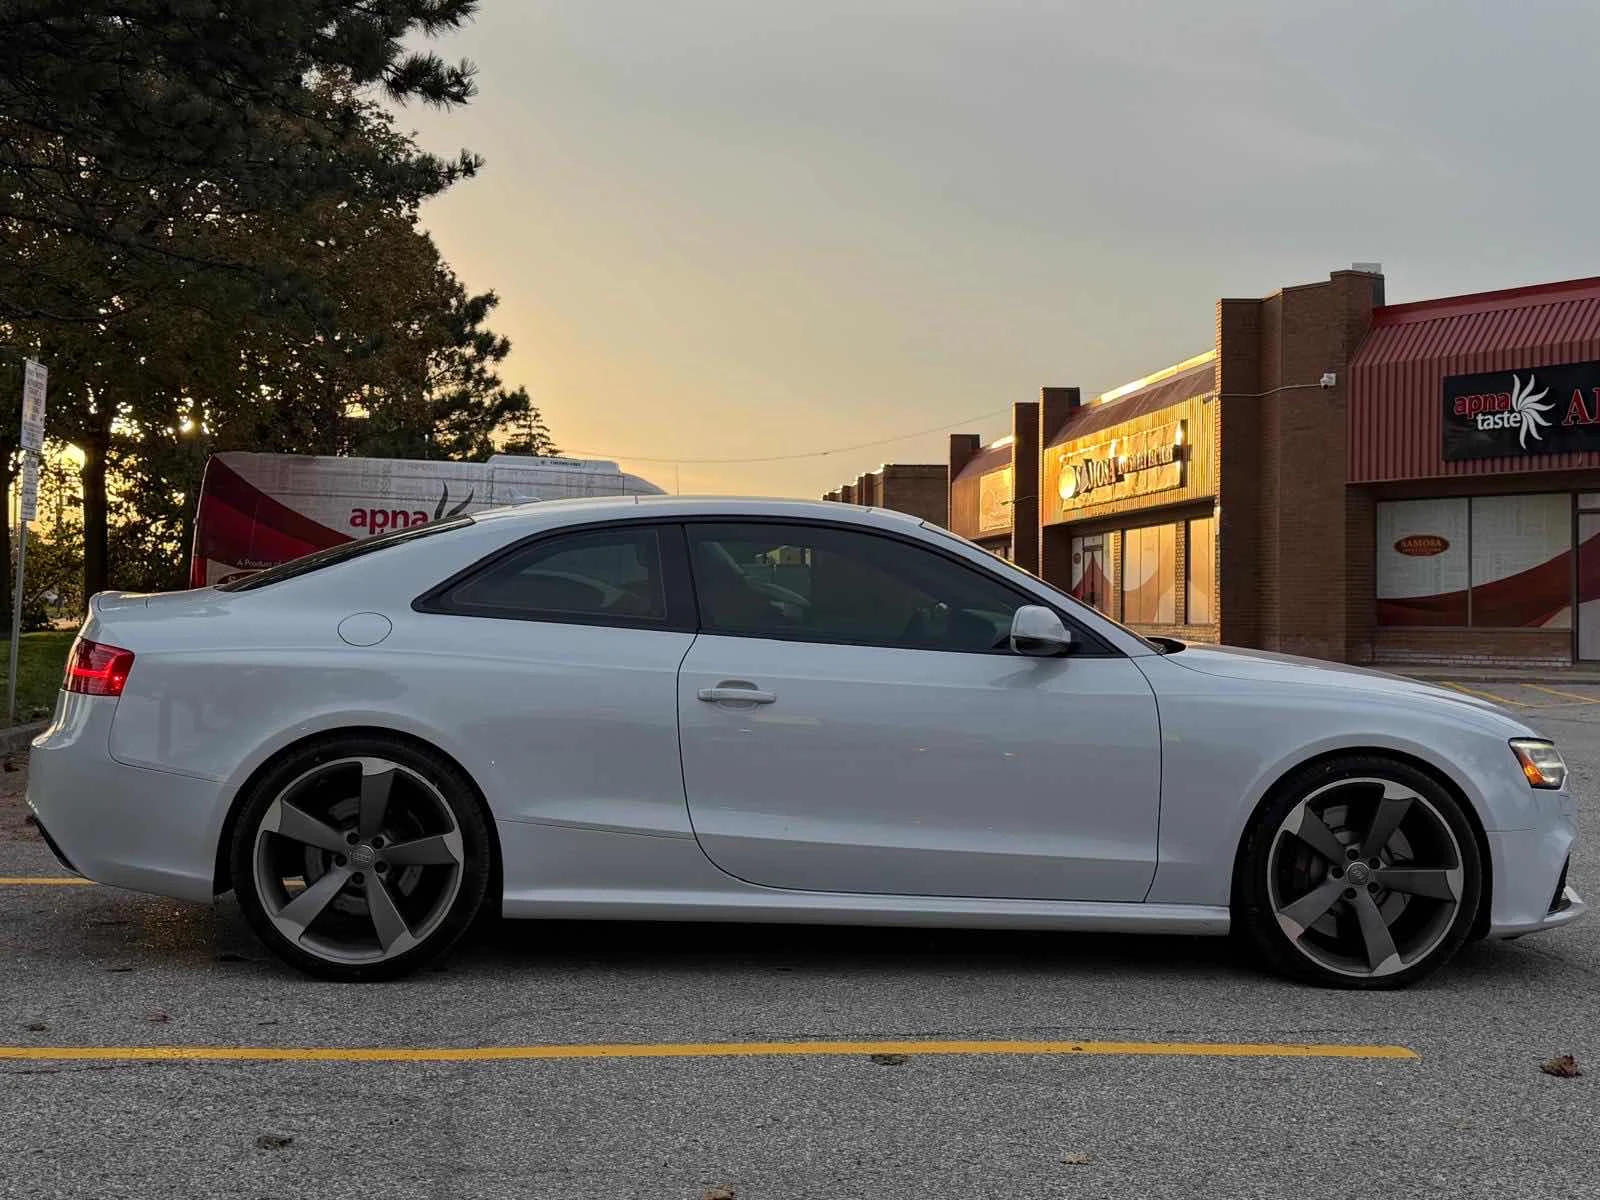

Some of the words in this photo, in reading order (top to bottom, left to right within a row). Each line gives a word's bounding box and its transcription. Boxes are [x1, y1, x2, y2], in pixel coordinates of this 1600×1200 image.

[1454, 393, 1512, 418] apna
[1476, 411, 1521, 430] taste
[349, 508, 429, 534] apna
